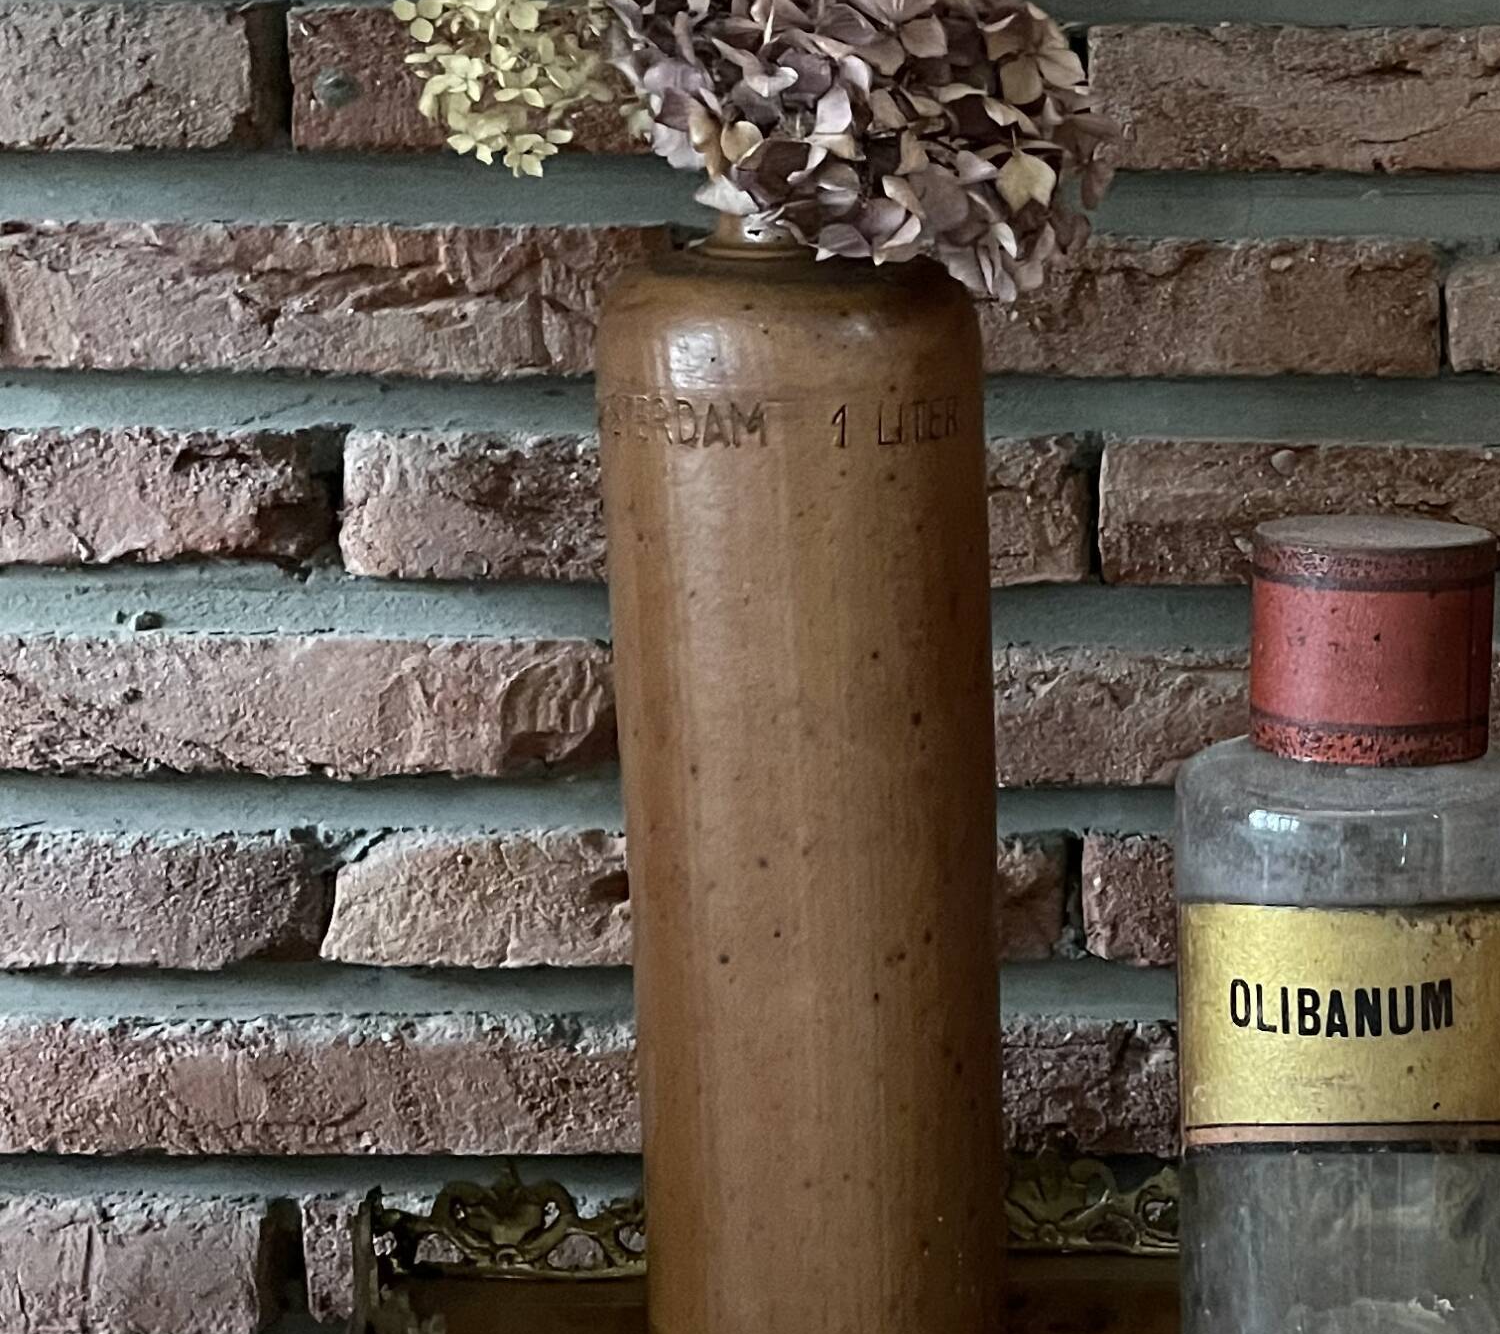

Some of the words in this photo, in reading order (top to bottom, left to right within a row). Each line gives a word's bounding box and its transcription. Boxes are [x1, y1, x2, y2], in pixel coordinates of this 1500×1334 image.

[831, 403, 848, 448] 1
[877, 398, 958, 445] LITER
[1230, 978, 1454, 1037] OLIBANUM
